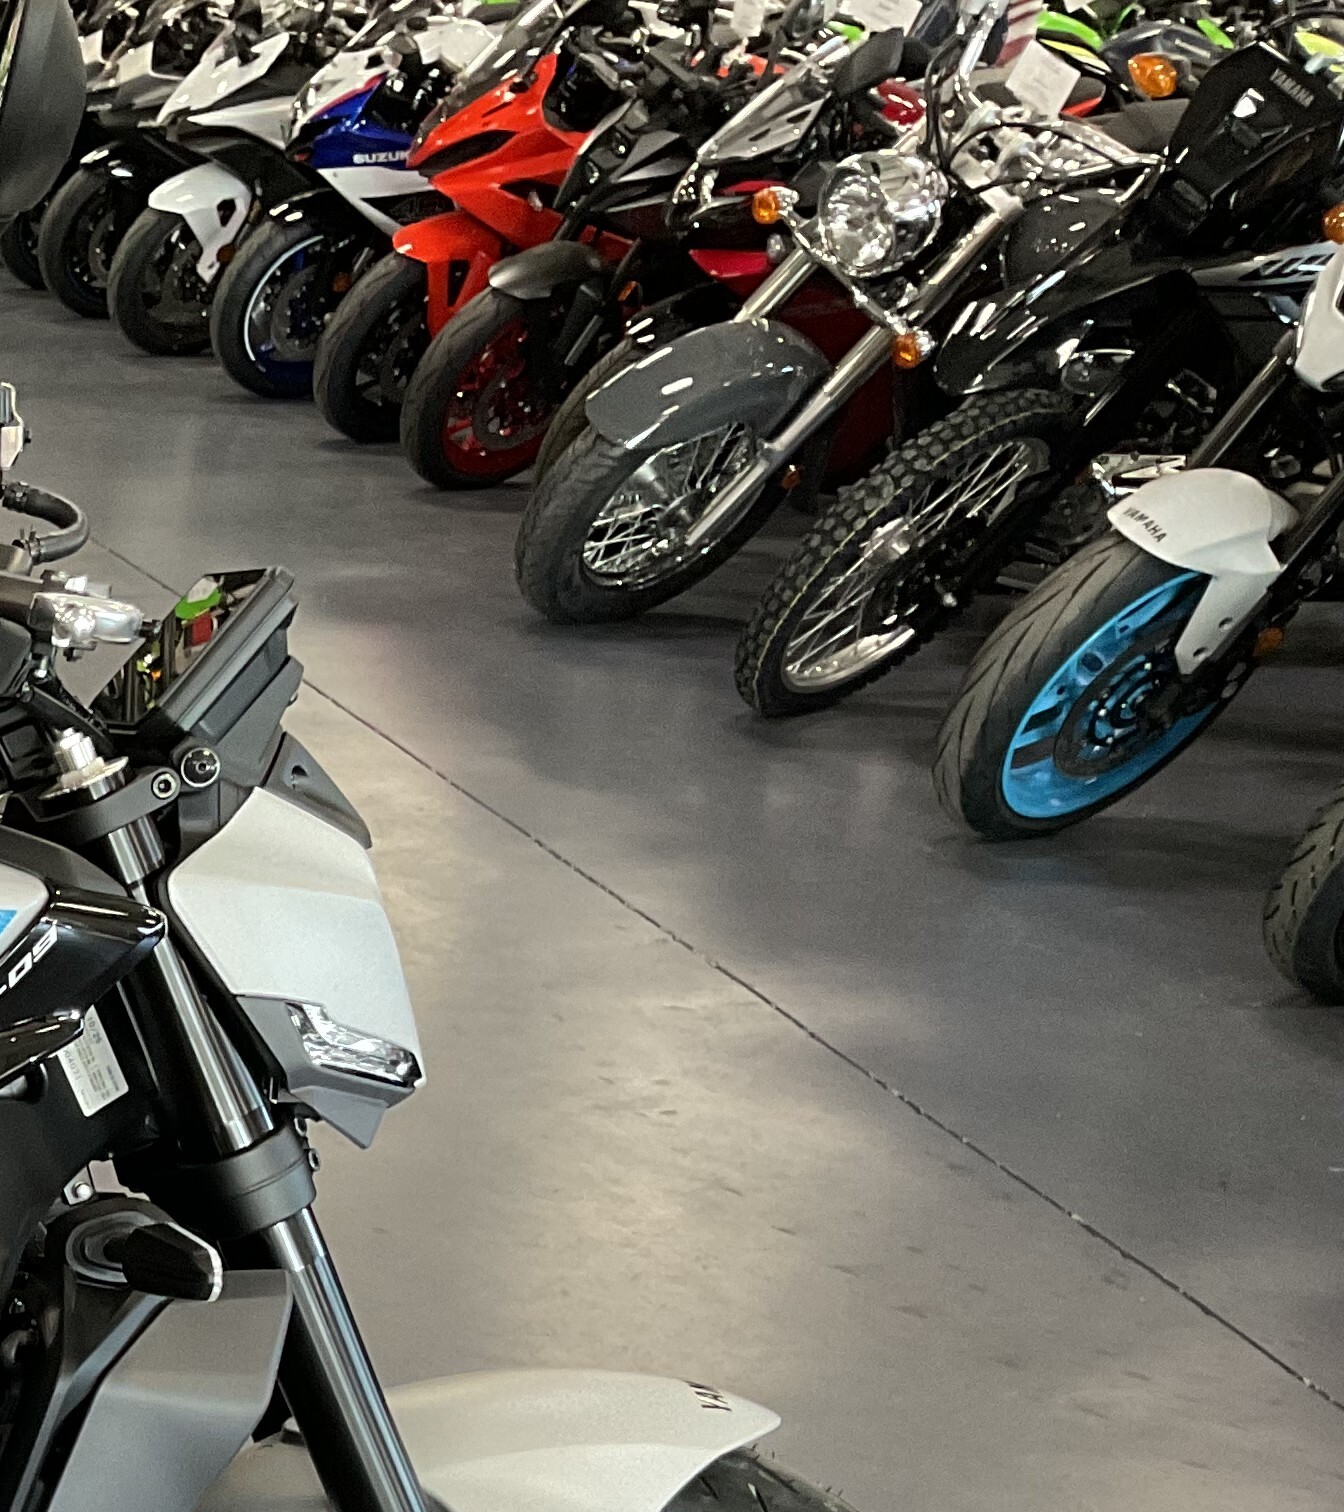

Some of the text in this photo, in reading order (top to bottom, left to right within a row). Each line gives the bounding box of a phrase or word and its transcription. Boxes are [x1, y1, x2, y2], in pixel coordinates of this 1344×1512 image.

[1270, 67, 1314, 108] YAMAHA
[352, 150, 412, 164] SUZUK
[1122, 506, 1168, 543] YAMAHA
